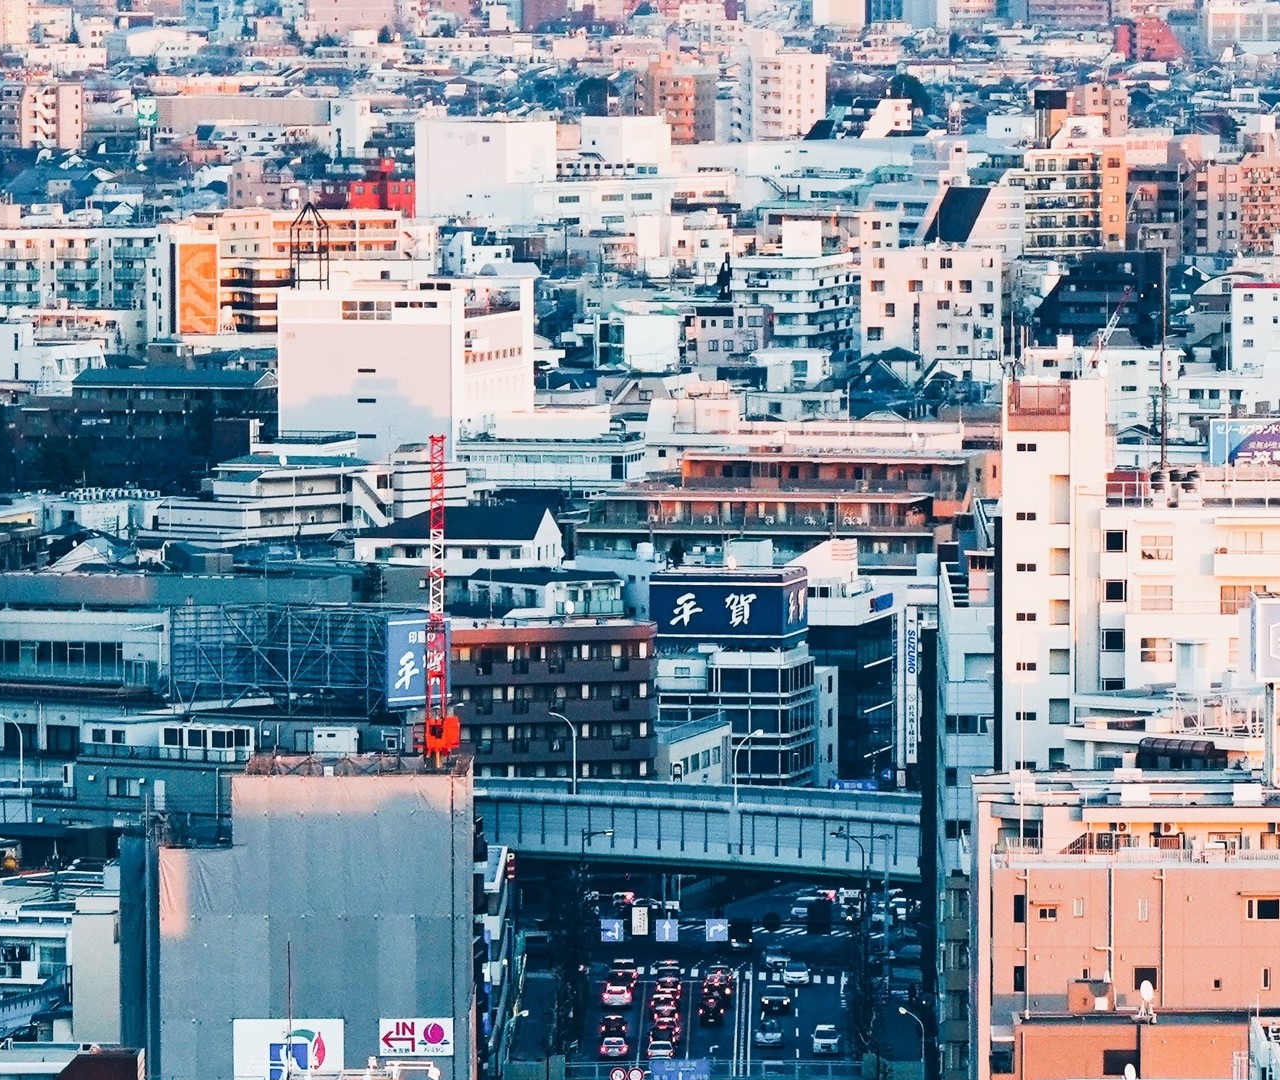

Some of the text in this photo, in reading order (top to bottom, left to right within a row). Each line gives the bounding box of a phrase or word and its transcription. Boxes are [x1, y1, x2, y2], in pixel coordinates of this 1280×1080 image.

[669, 592, 757, 627] 平賀
[907, 629, 916, 674] SUZUMO
[395, 1021, 415, 1036] IN
